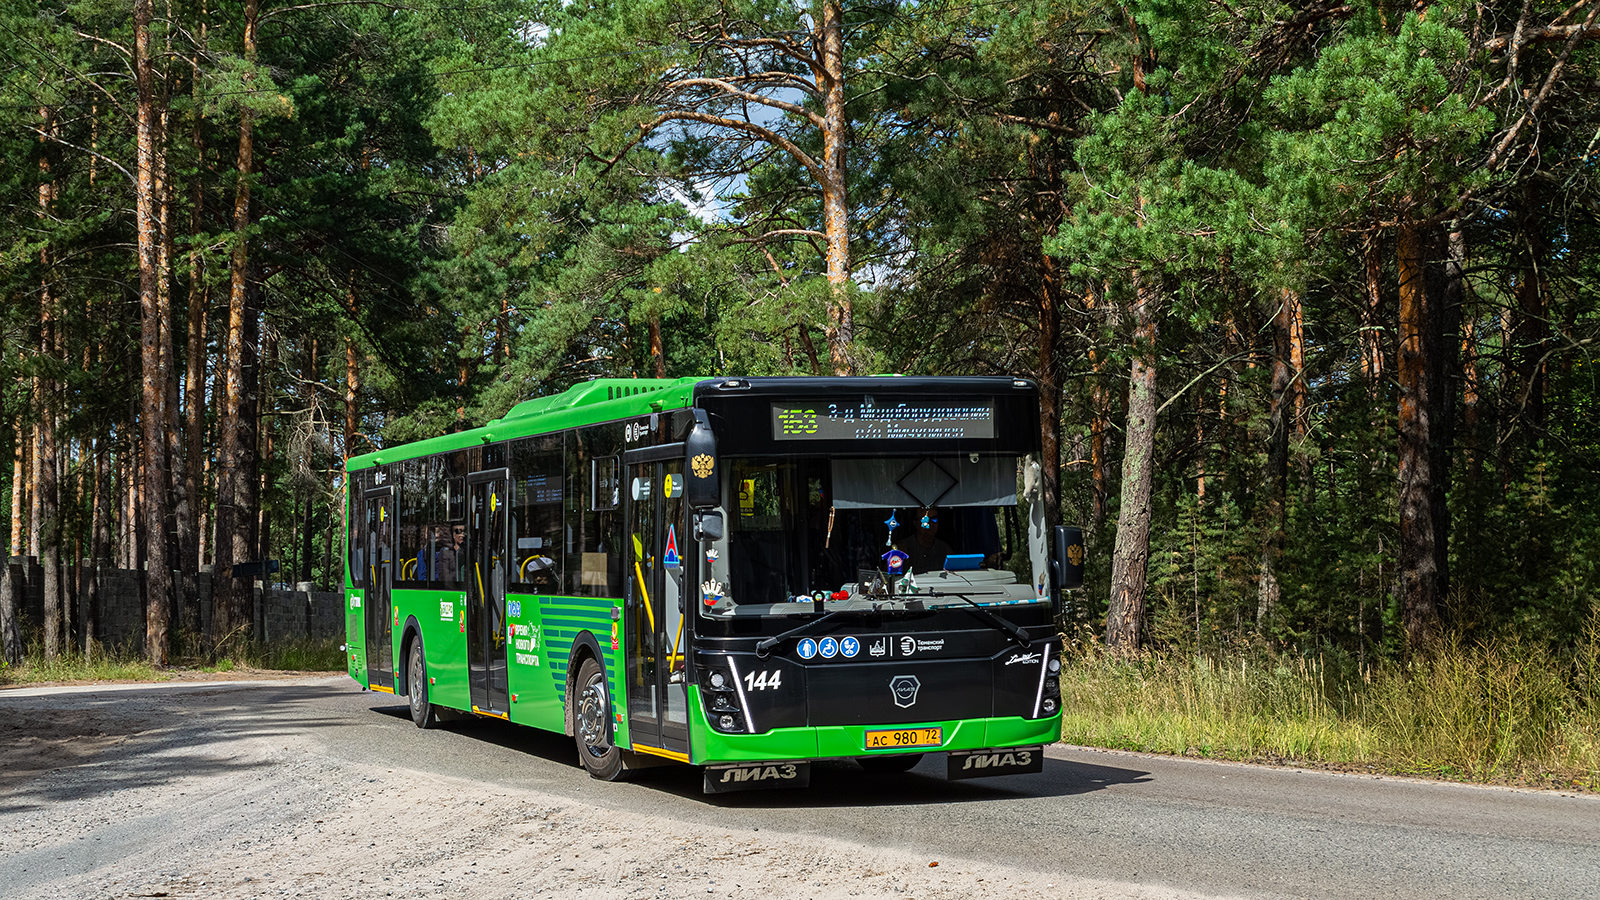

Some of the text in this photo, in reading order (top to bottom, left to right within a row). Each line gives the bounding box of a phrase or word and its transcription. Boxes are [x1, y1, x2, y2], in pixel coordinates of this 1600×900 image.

[778, 409, 818, 434] 153
[744, 669, 782, 692] 144
[893, 731, 917, 745] 980
[924, 729, 937, 740] 72
[962, 751, 1031, 770] ЛИАЗ
[720, 764, 797, 783] ЛИАЗ
